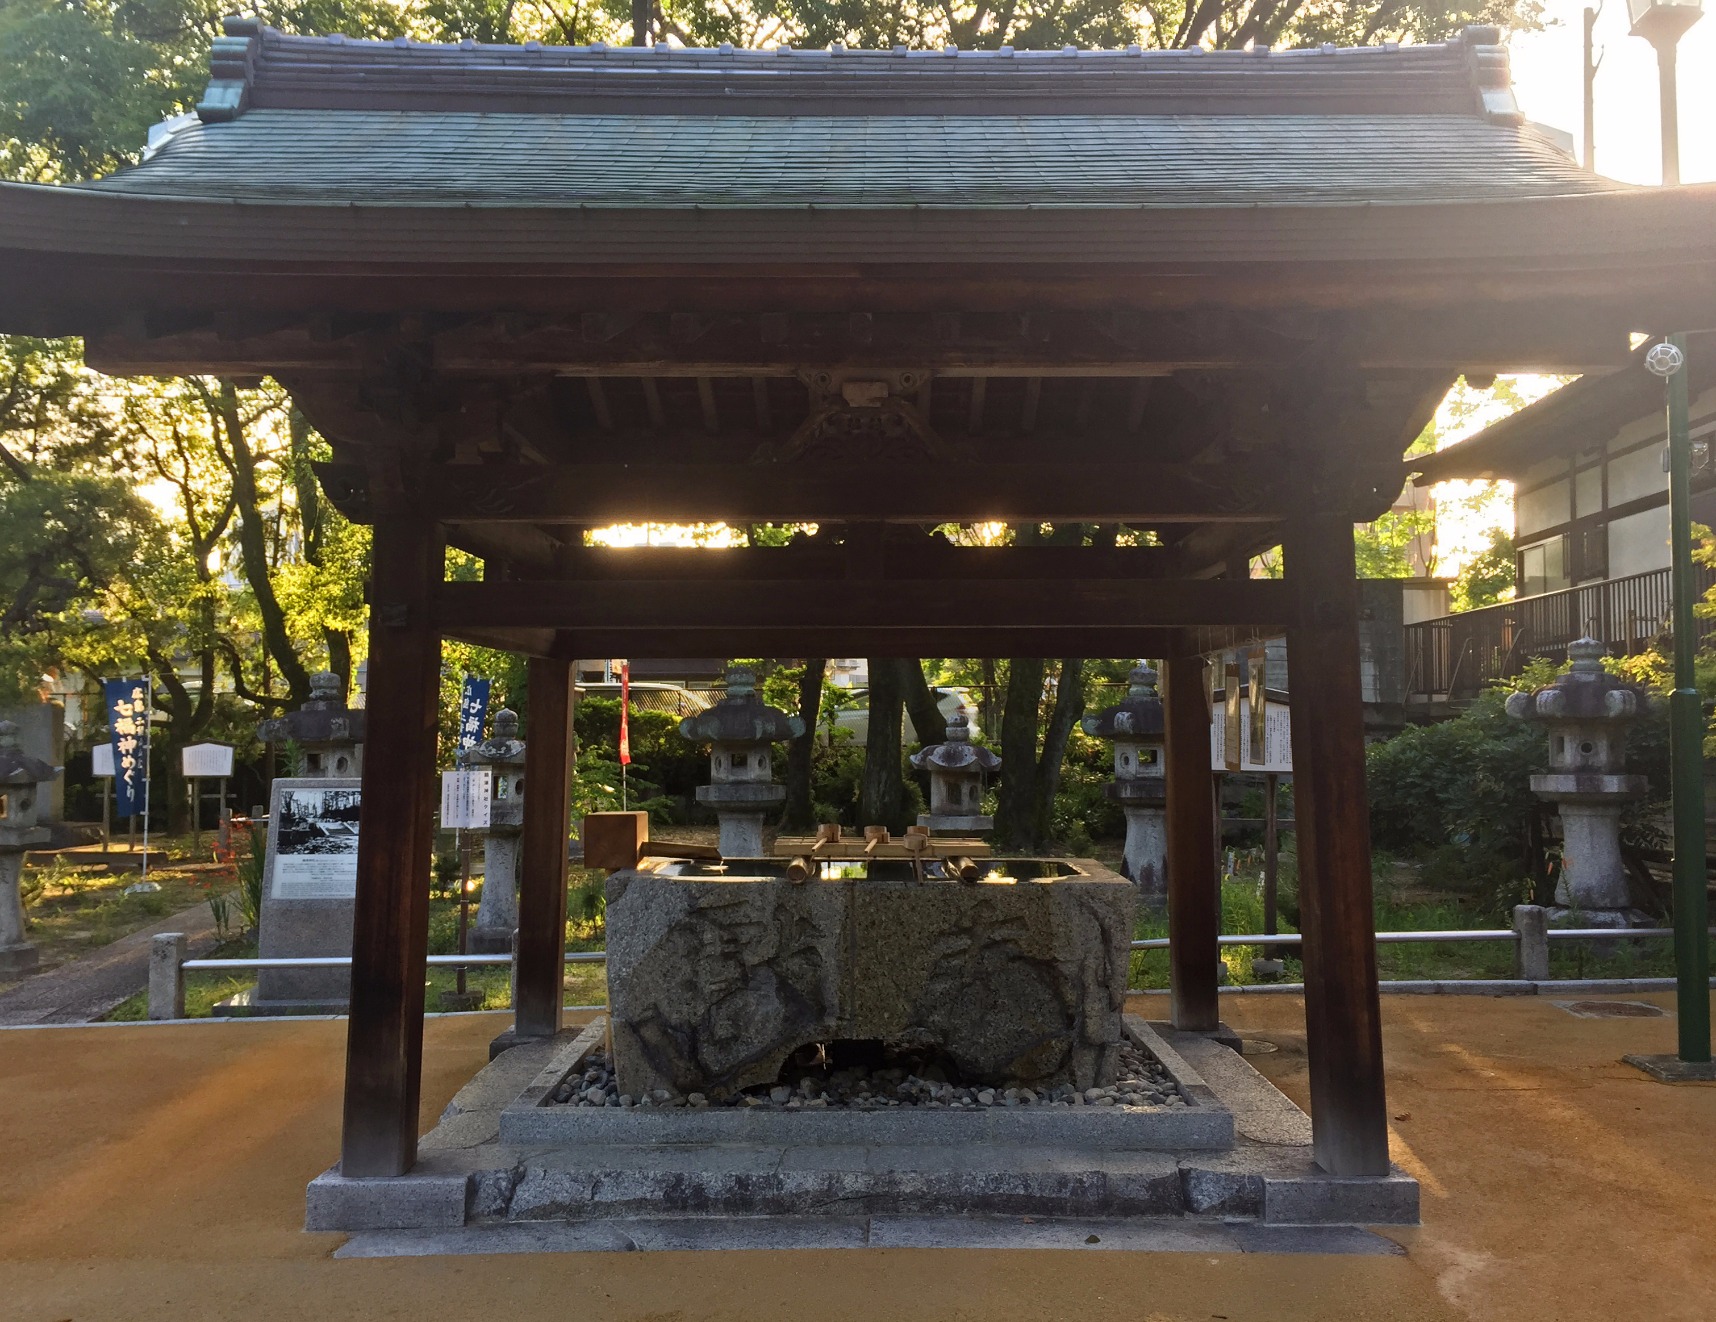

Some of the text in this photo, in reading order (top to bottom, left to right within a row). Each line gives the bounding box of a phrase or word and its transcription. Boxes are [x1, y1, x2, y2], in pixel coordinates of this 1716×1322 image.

[113, 699, 138, 802] 七福神めぐり
